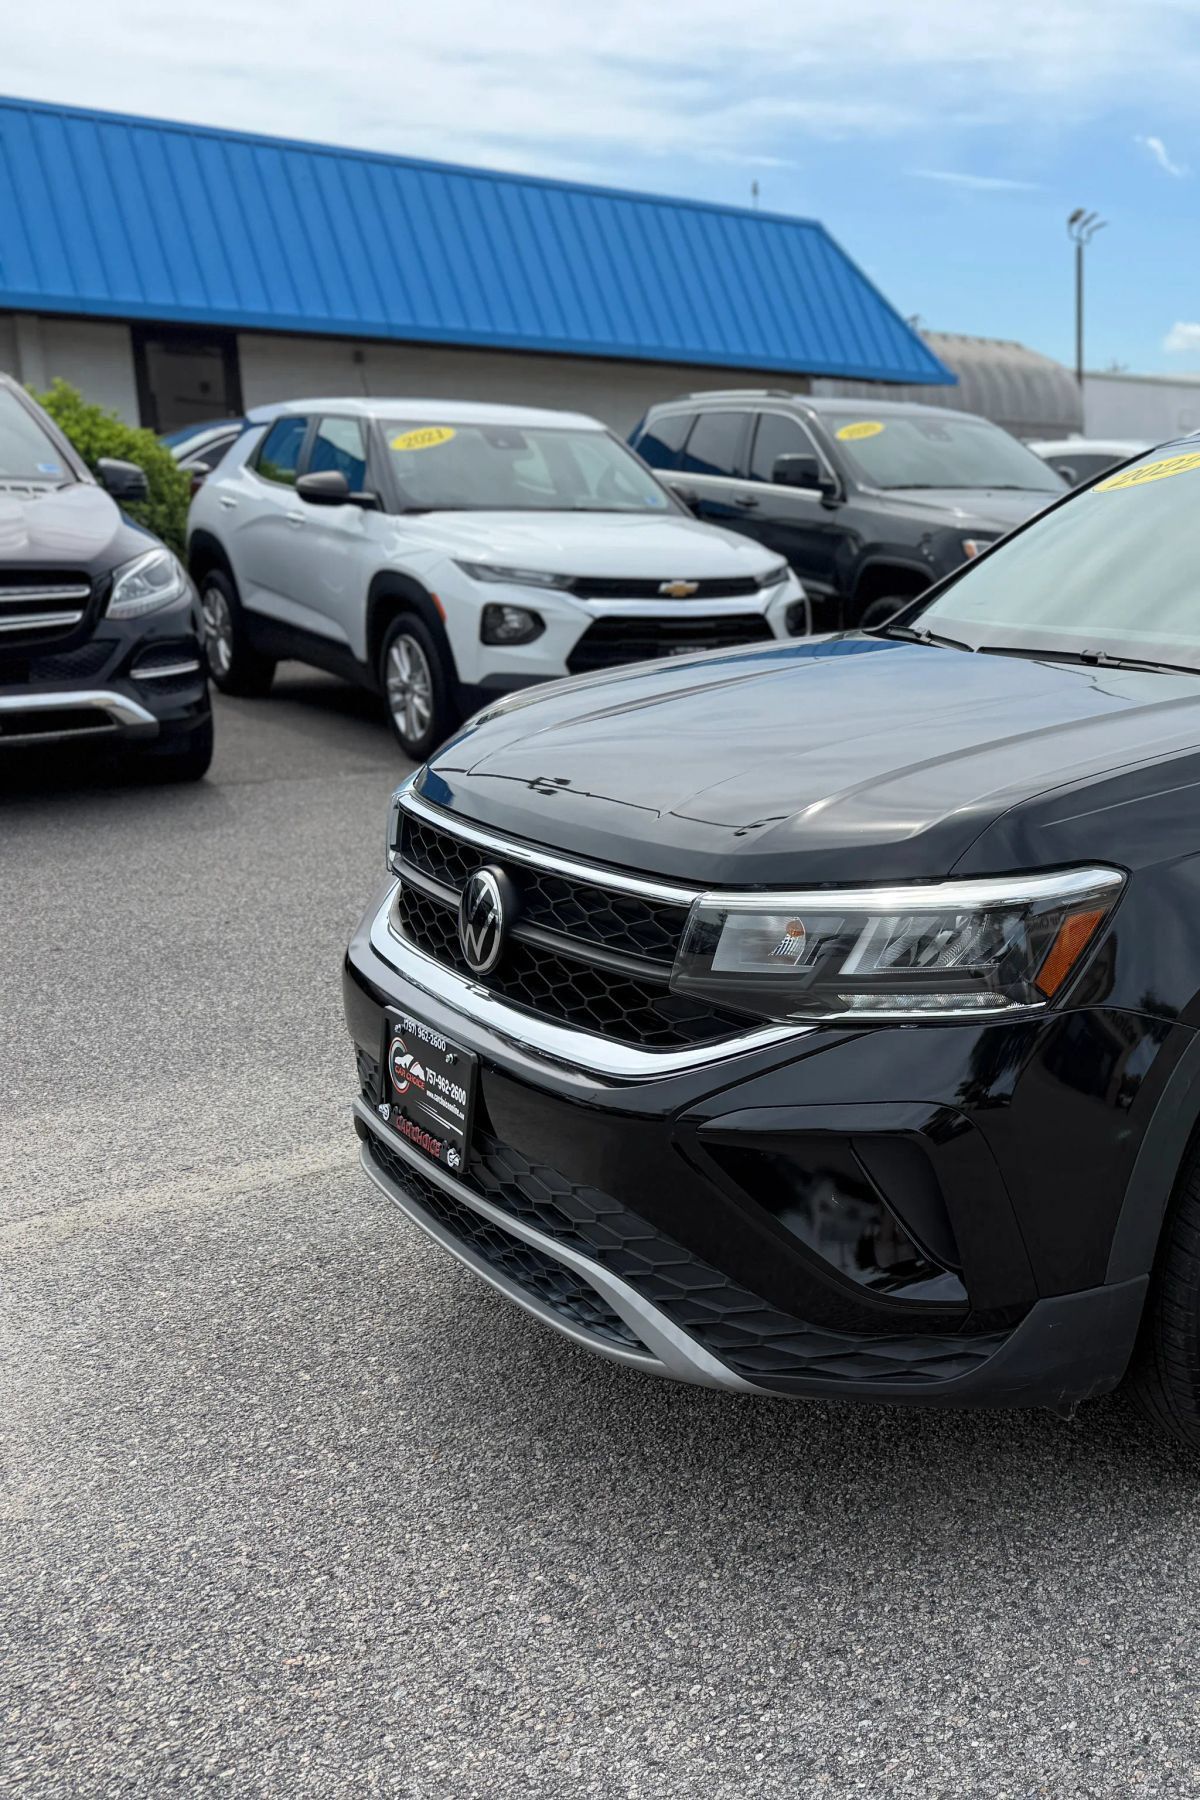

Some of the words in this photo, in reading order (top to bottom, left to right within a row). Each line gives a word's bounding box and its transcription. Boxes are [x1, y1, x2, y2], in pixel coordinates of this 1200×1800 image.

[417, 1027, 446, 1052] 962-2600
[394, 1065, 406, 1078] CAR
[405, 1072, 425, 1090] CHOICE
[425, 1066, 467, 1106] 757-962-2600
[396, 1115, 412, 1137] CAR
[411, 1126, 441, 1158] CHOICE
